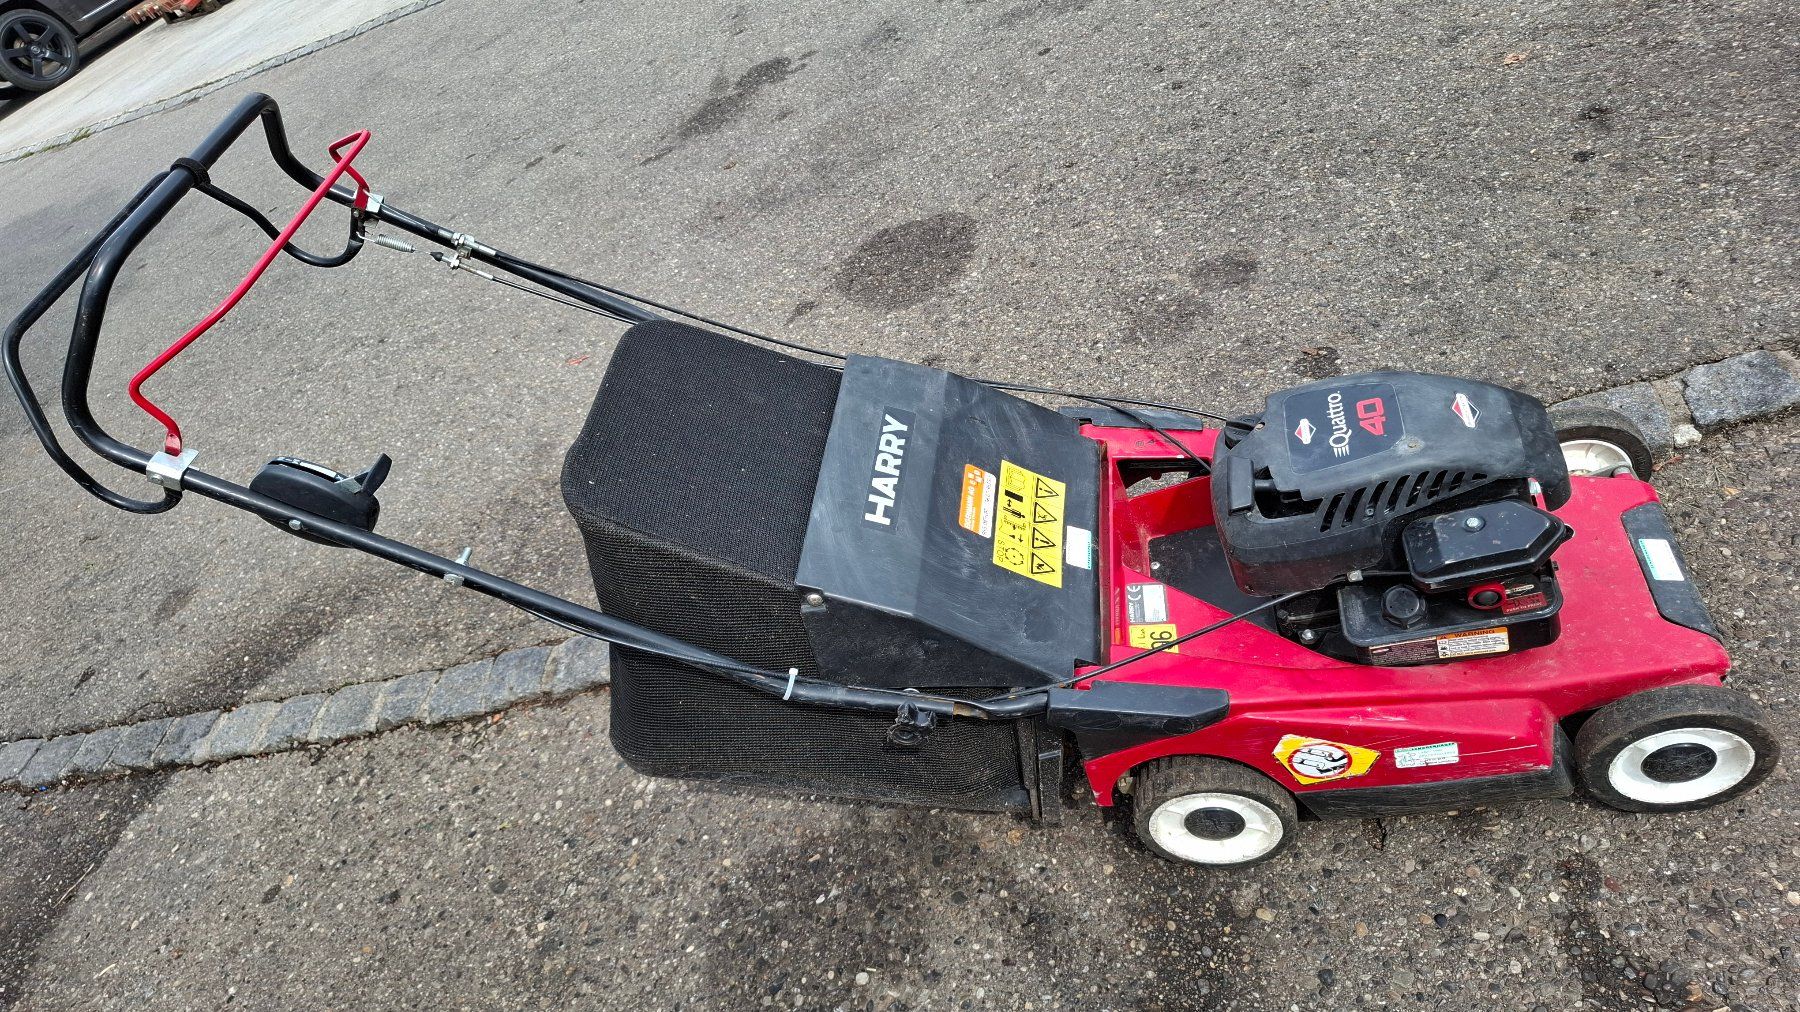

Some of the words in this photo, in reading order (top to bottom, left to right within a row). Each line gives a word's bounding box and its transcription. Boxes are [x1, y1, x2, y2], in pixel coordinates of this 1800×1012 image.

[1356, 398, 1385, 435] 40
[865, 414, 908, 525] HARRY
[997, 540, 1005, 562] STOP
[1454, 630, 1495, 638] WARNING
